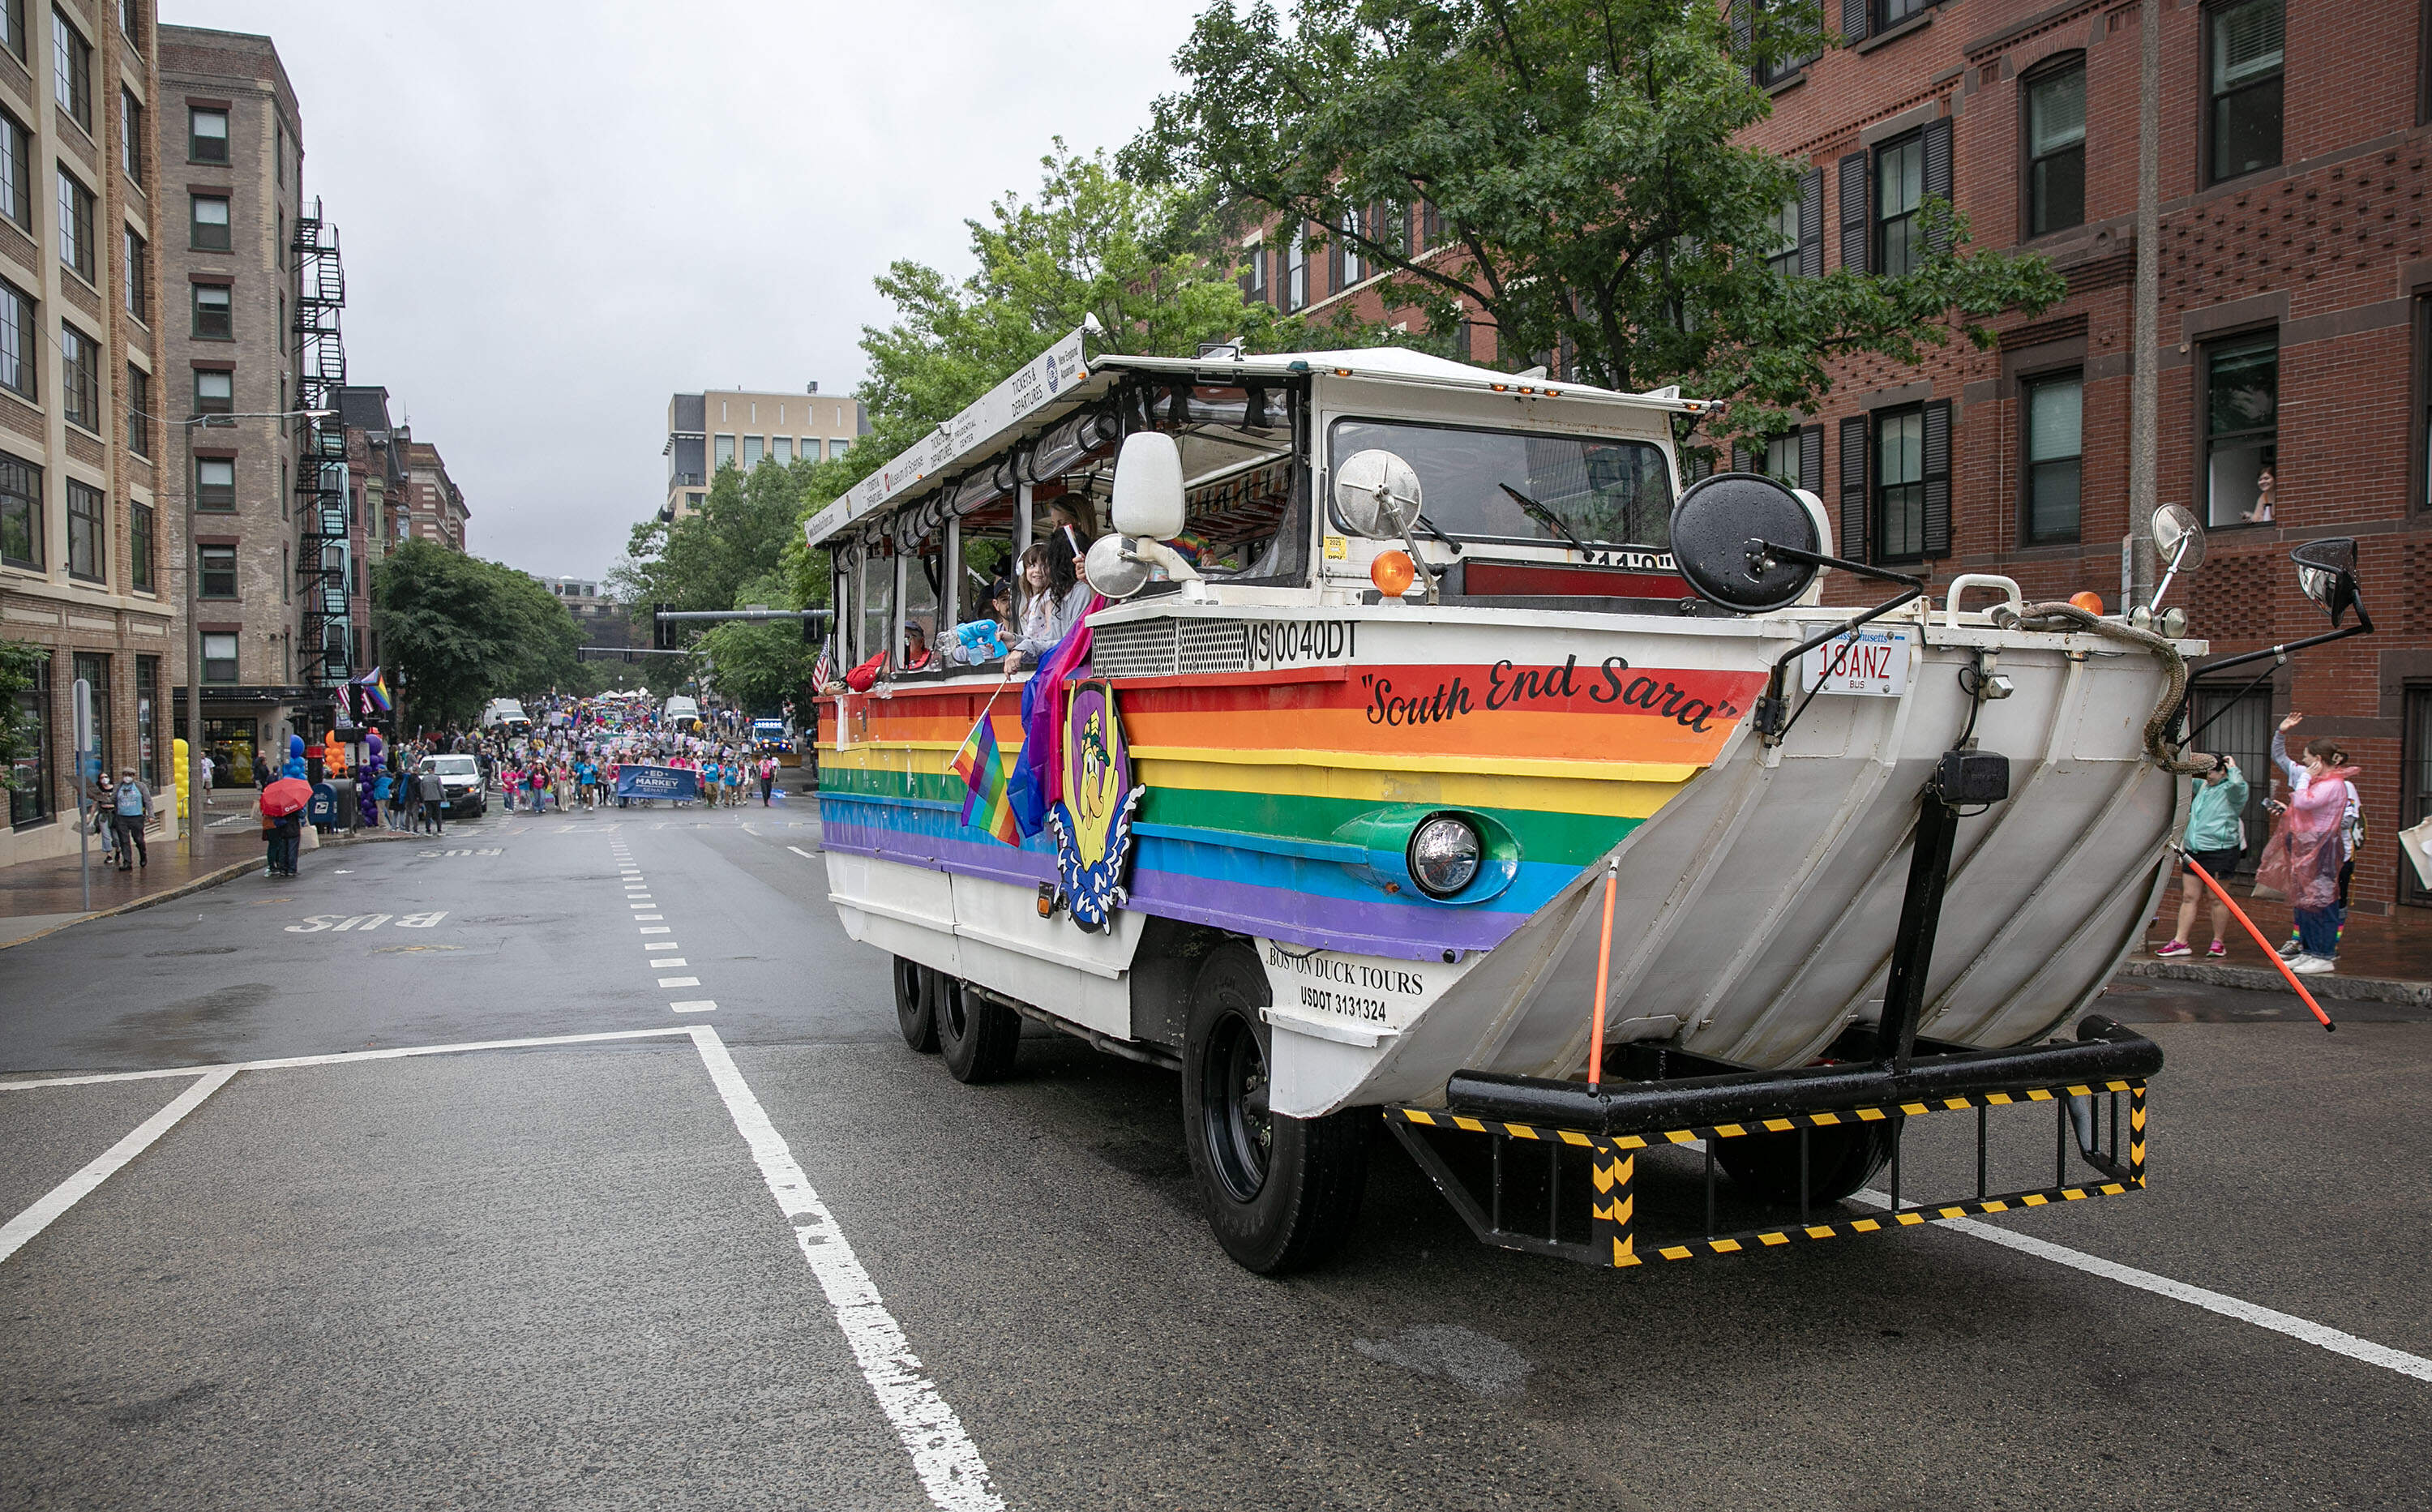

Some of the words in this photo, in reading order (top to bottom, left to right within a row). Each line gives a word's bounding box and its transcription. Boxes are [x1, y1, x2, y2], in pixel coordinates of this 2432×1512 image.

[1012, 370, 1031, 396] TICKETS
[1032, 366, 1037, 382] &
[1011, 383, 1043, 418] DEPARTURES
[960, 433, 974, 448] CENTER
[931, 443, 953, 469] DEPARTURES
[1818, 643, 1891, 679] 18ANZ
[1486, 654, 1581, 711] End
[636, 778, 679, 787] MARKEY
[416, 847, 504, 858] BUS
[284, 910, 450, 933] BUS
[1270, 947, 1313, 975] BOSTON
[1316, 957, 1355, 985] DUCK
[1359, 966, 1424, 996] TOURS
[1300, 986, 1332, 1012] USDOT
[1335, 994, 1386, 1022] 3131324
